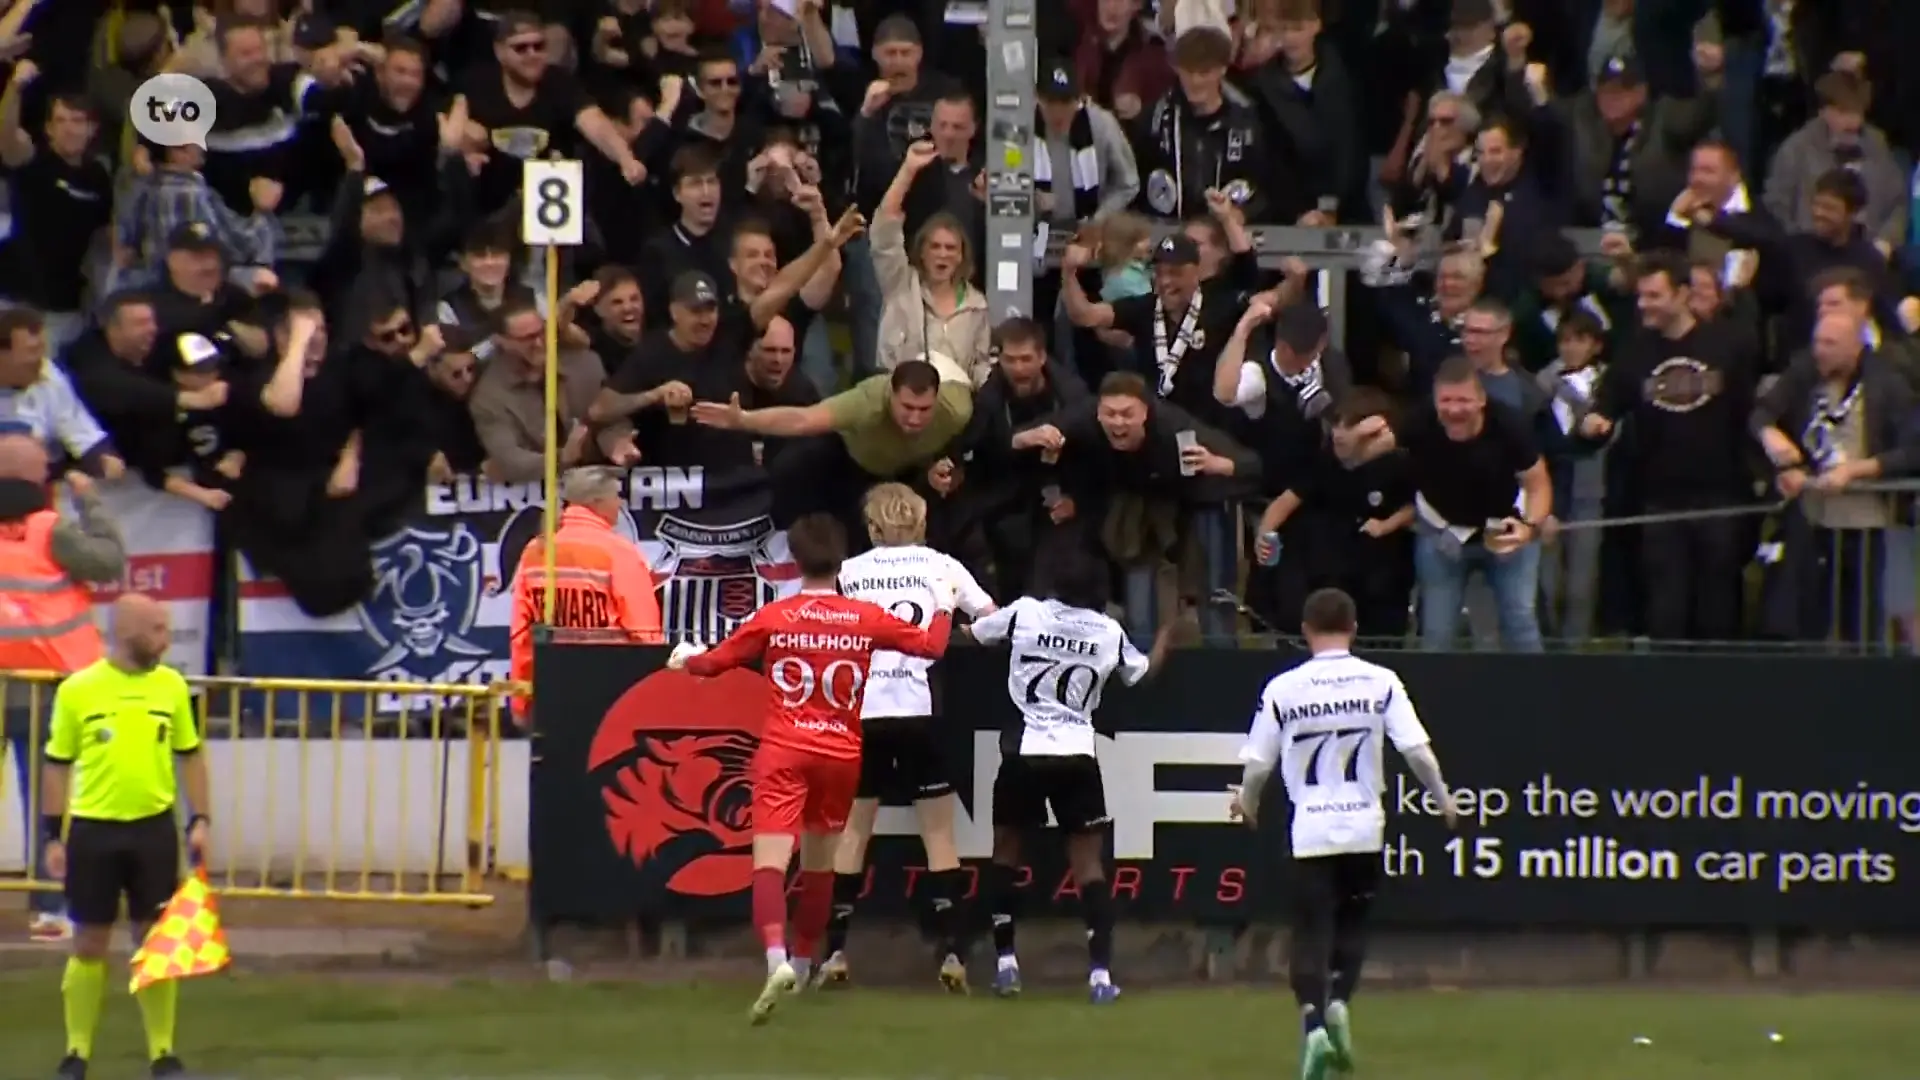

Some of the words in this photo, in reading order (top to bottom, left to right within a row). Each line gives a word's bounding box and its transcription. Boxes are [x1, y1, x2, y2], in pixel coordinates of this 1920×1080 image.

[538, 177, 570, 230] 8
[426, 466, 704, 515] EURAN
[1037, 633, 1100, 656] NDEFE
[771, 656, 863, 712] 90
[1019, 653, 1099, 711] 70
[1292, 726, 1372, 786] 77
[1397, 773, 1510, 827] keep
[1522, 773, 1600, 817] the
[1611, 775, 1742, 819] world
[1756, 780, 1920, 832] moving
[1384, 833, 1425, 877] th
[1444, 837, 1503, 878] 15
[1519, 836, 1681, 880] million
[1695, 851, 1768, 881] car
[1778, 848, 1896, 892] parts
